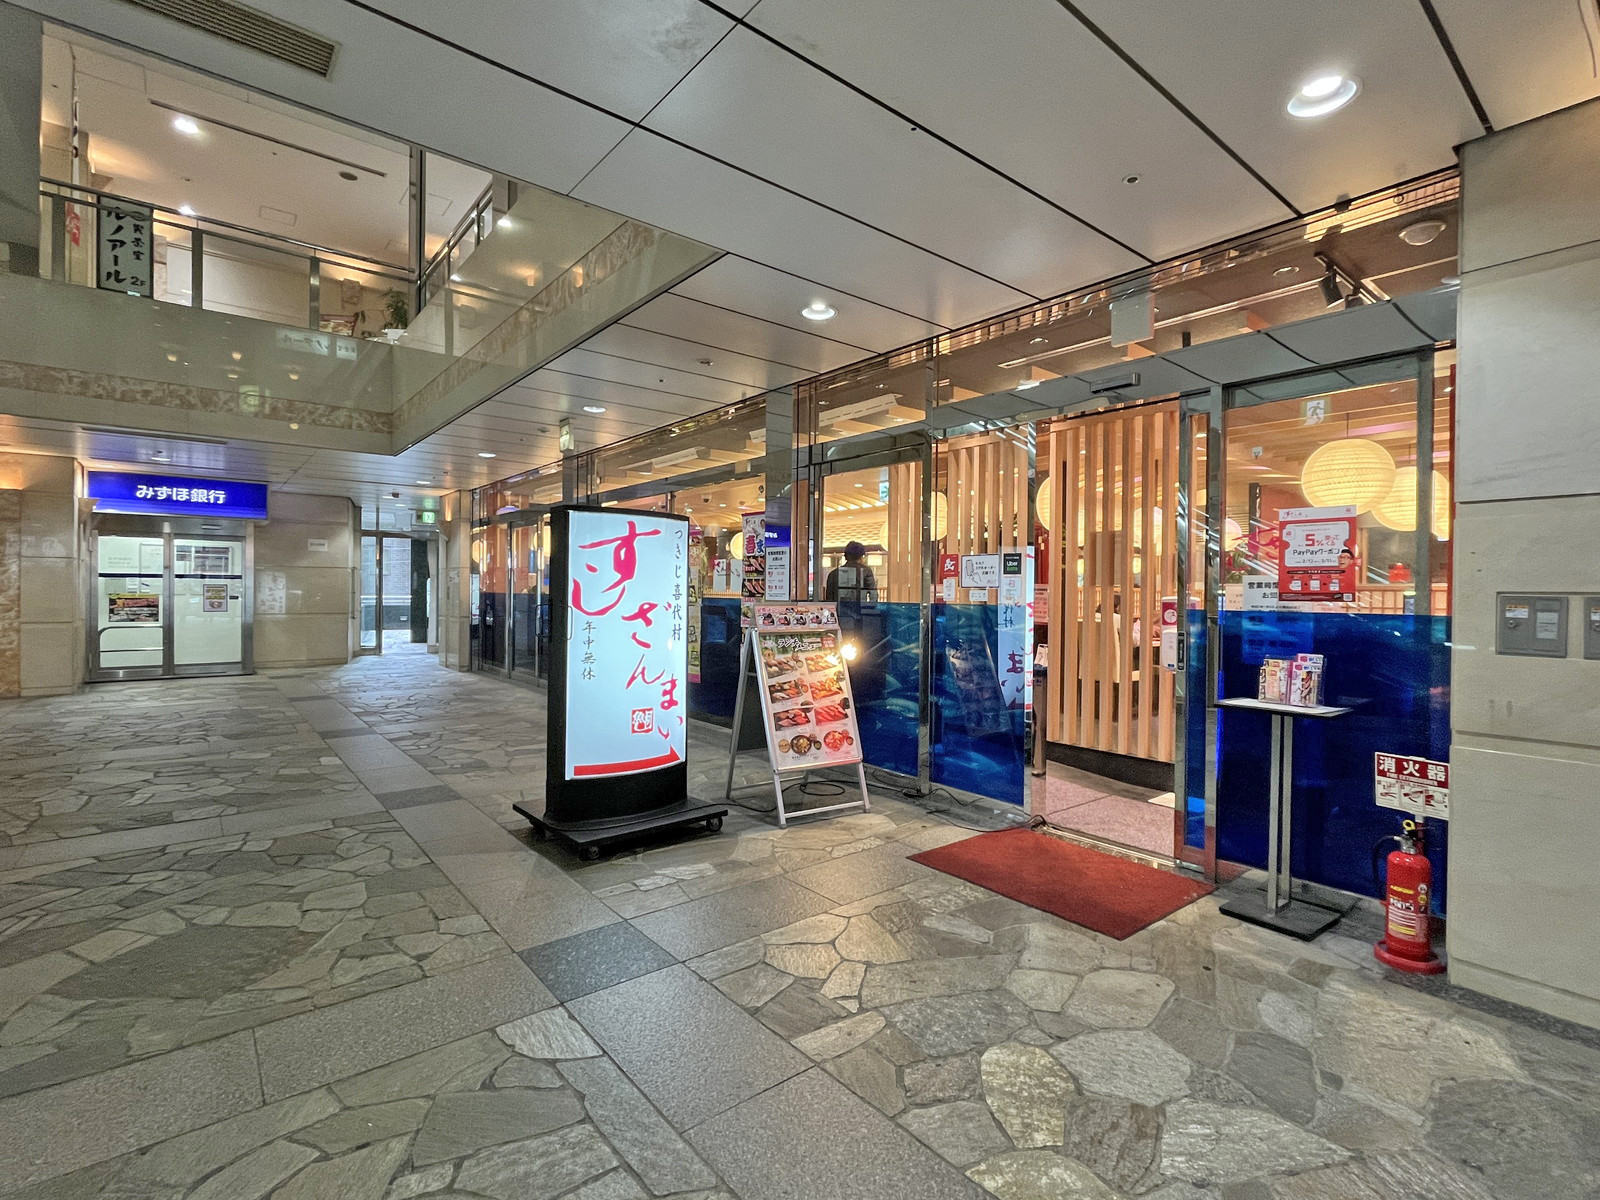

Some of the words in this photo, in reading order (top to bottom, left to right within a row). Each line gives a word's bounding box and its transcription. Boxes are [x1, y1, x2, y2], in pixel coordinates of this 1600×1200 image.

[130, 276, 146, 286] 2F
[136, 485, 226, 504] みずほ銀行
[1305, 533, 1324, 547] 5%
[1293, 548, 1340, 556] PayPayクーポン
[672, 529, 683, 641] つきじ喜代村
[572, 520, 684, 740] すしざんまい
[581, 620, 597, 681] 年中無休
[1379, 755, 1446, 782] 消火器
